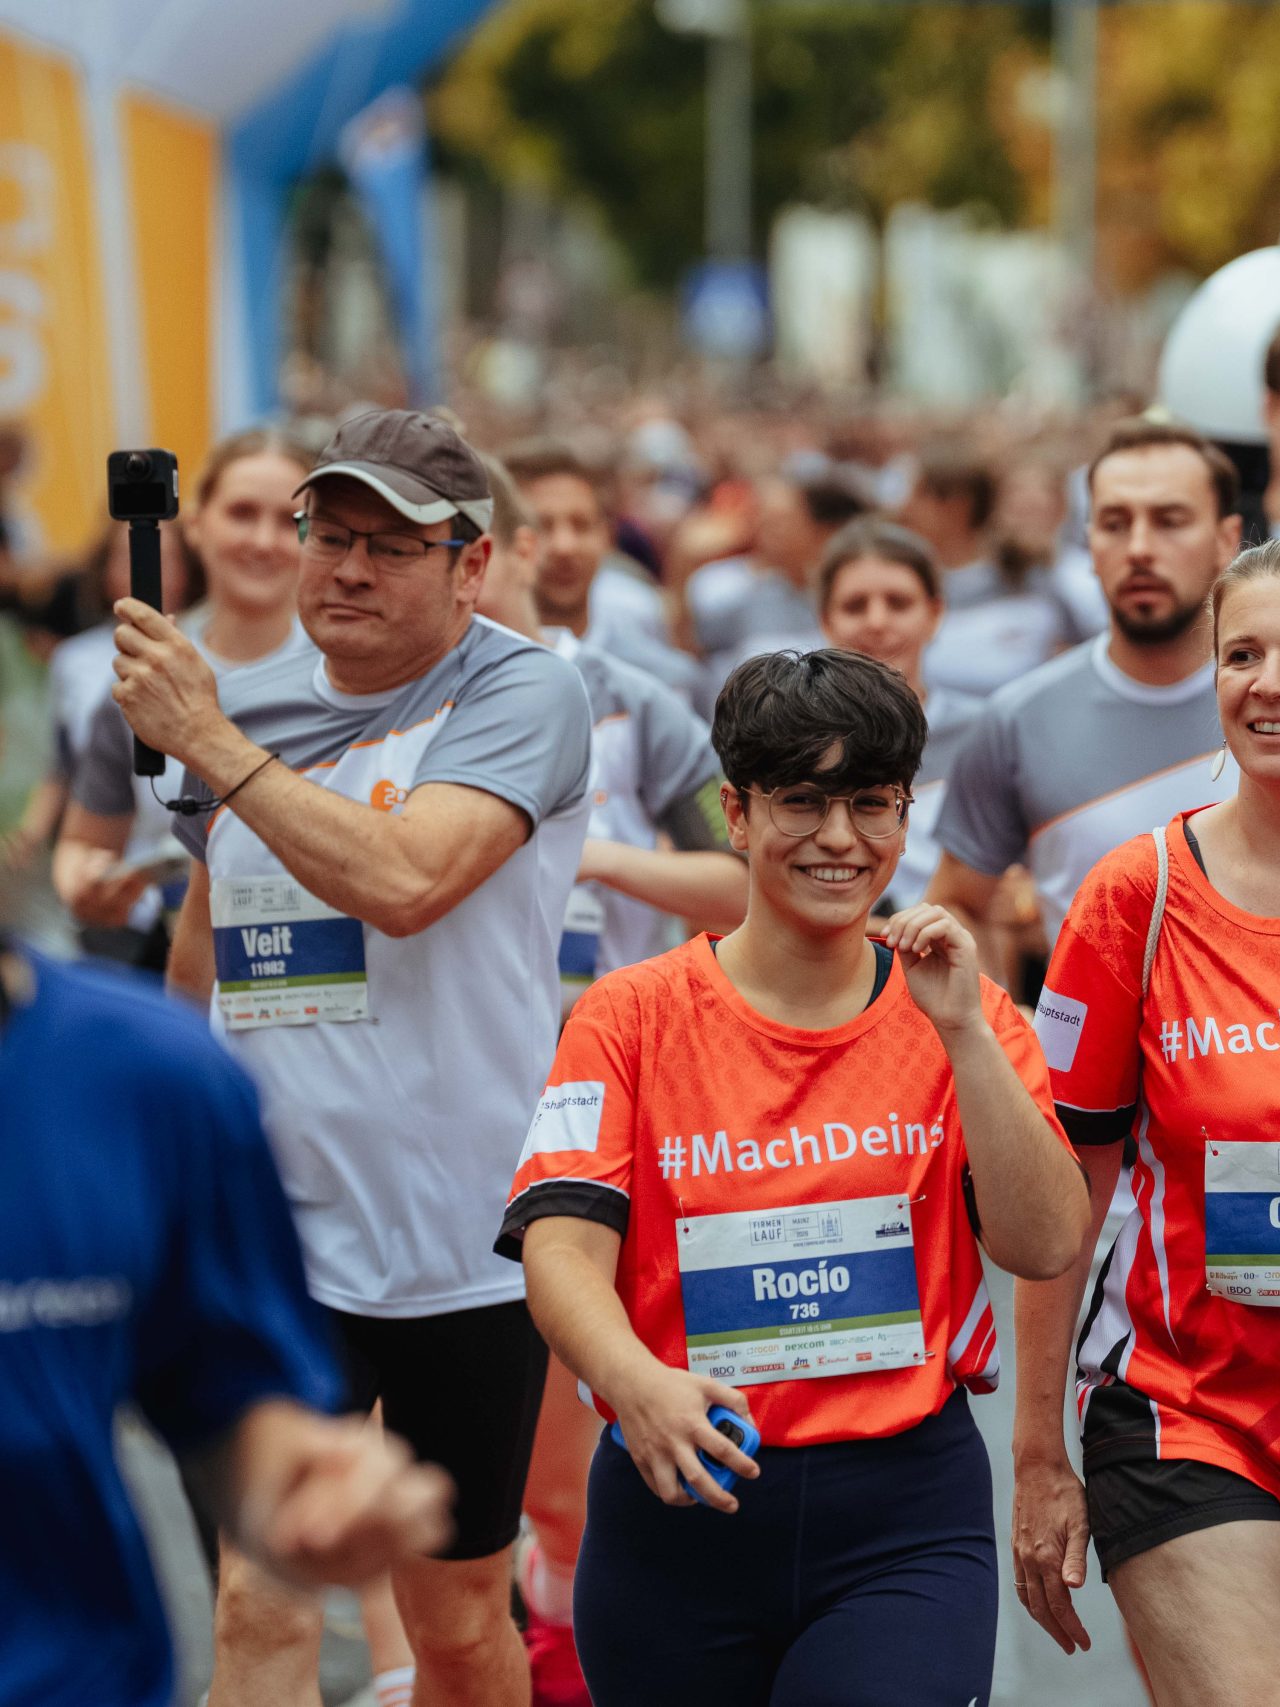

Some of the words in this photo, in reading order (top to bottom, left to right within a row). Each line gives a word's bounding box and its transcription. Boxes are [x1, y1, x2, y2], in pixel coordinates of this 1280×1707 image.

[240, 925, 293, 957] Veit
[1038, 1001, 1081, 1027] auptstadt
[657, 1111, 945, 1180] #MachDeins
[753, 1219, 781, 1229] FIRMEN
[754, 1229, 782, 1242] LAUF
[752, 1260, 850, 1301] Rocío
[1229, 1286, 1252, 1295] BDO
[789, 1303, 820, 1320] 736
[712, 1366, 735, 1376] BDO
[794, 1357, 808, 1366] dm
